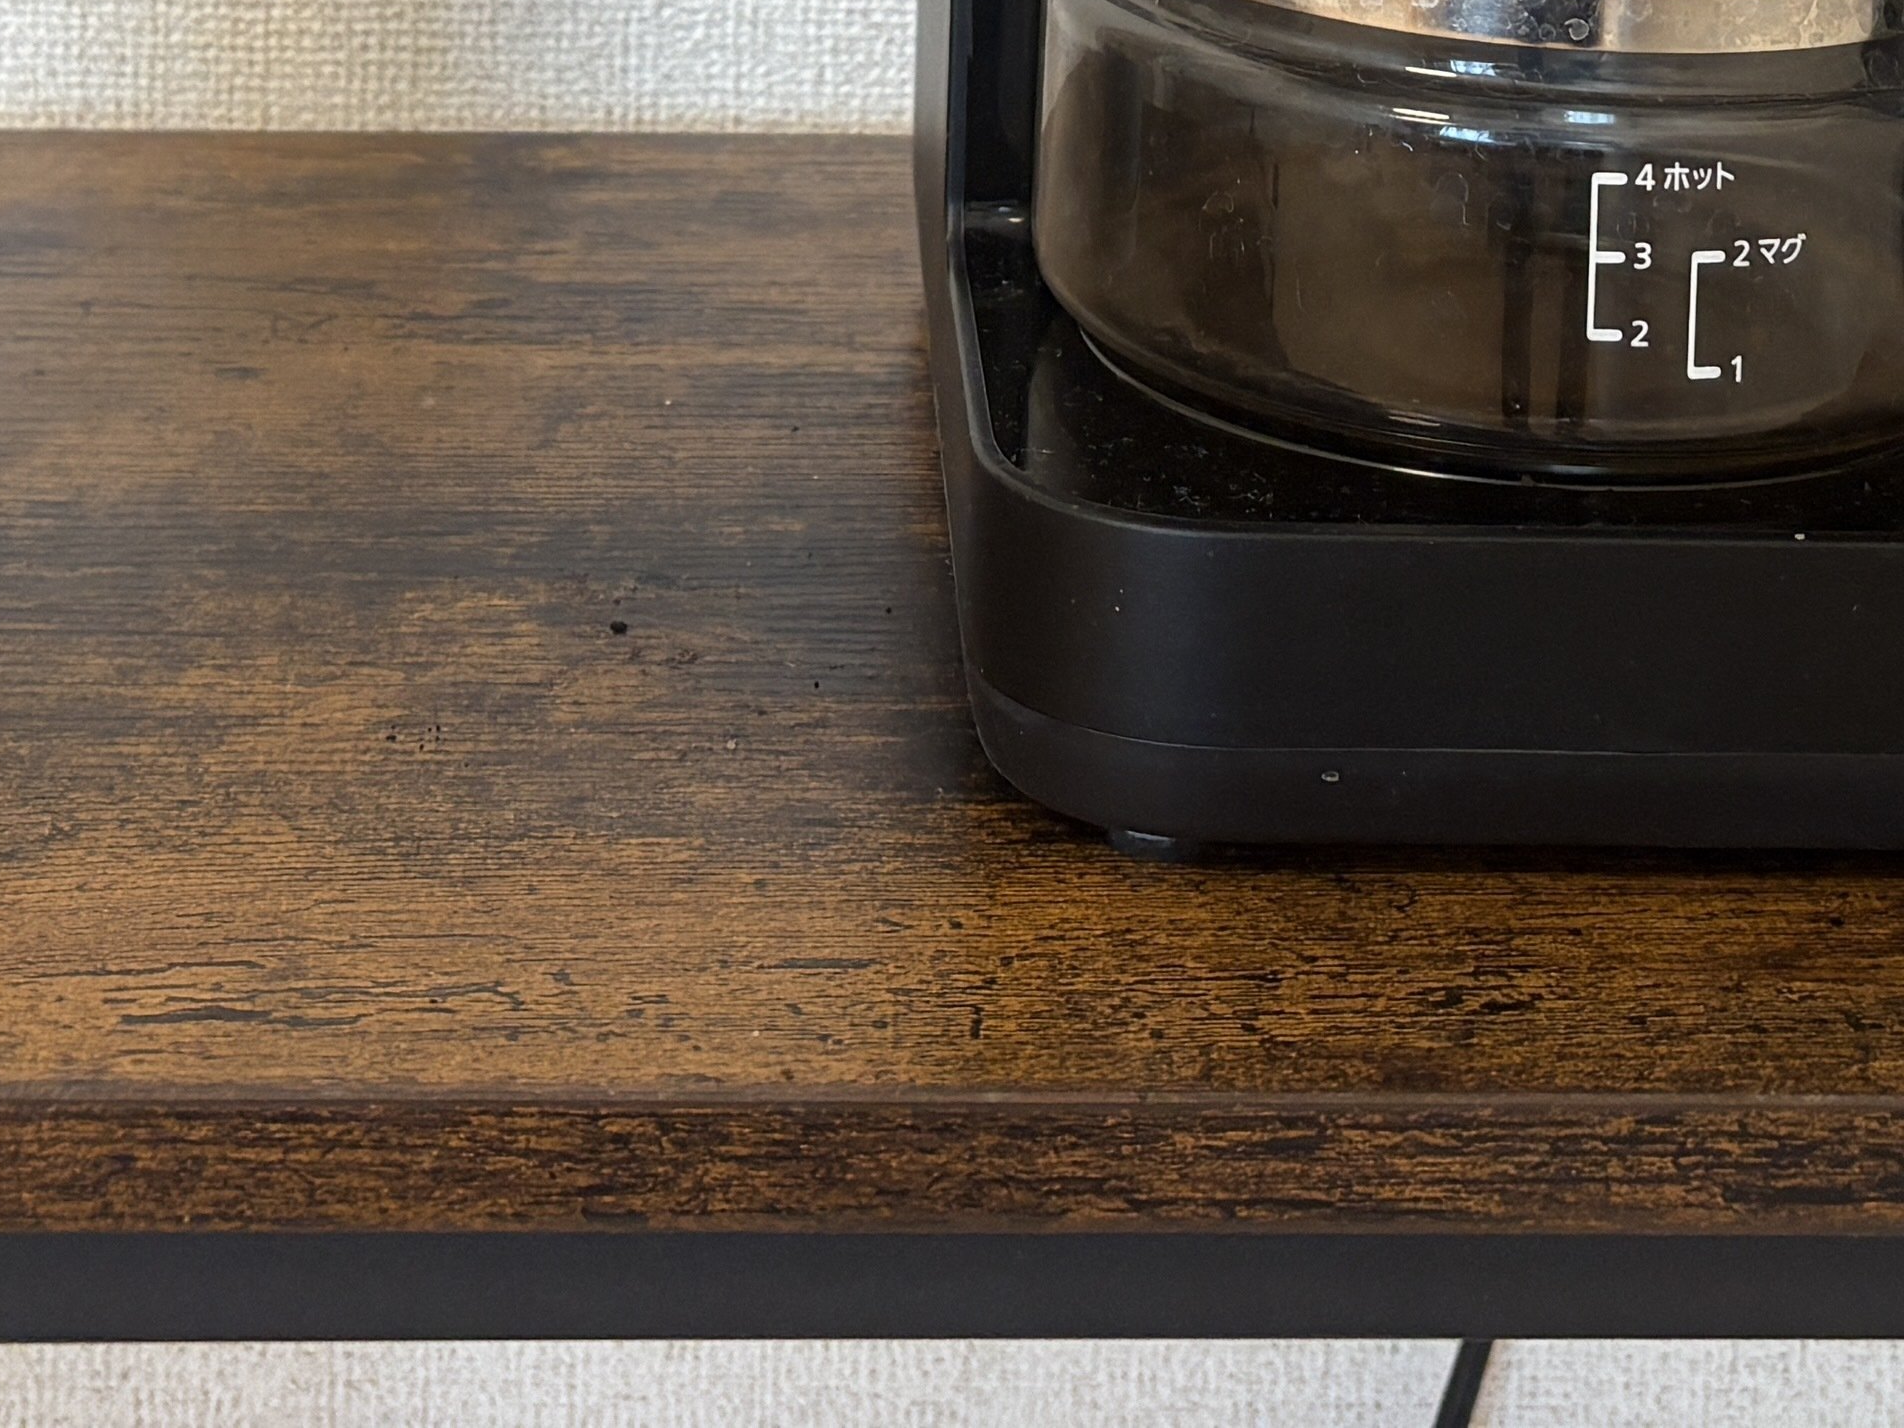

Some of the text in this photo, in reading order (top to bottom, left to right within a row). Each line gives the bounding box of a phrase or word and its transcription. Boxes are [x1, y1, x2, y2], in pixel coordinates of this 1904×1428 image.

[1634, 161, 1736, 192] 4 ホット
[1633, 242, 1652, 270] 3
[1732, 232, 1807, 267] 2 マグ
[1630, 320, 1649, 348] 2
[1730, 355, 1743, 383] 1
